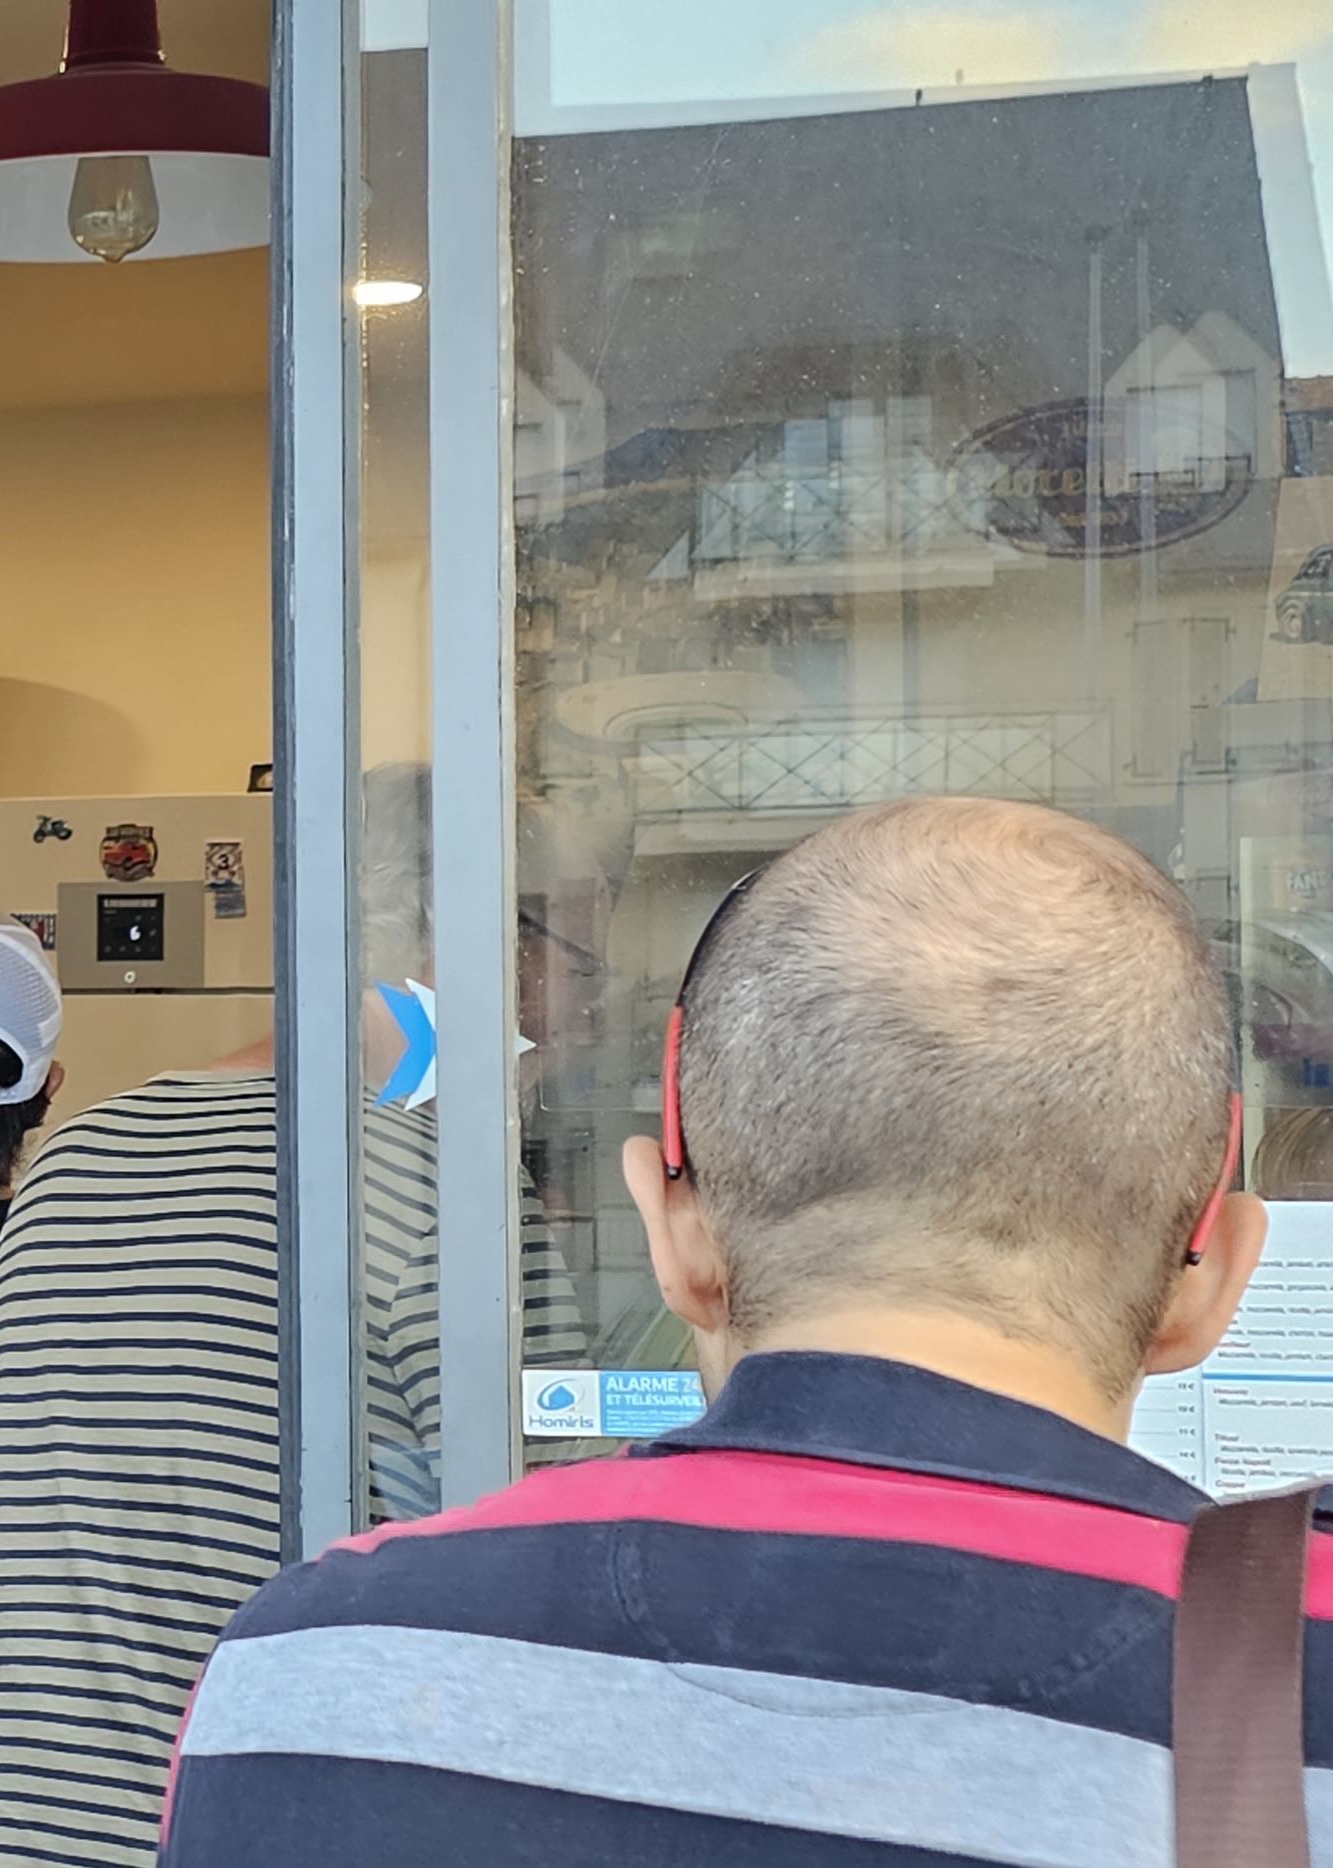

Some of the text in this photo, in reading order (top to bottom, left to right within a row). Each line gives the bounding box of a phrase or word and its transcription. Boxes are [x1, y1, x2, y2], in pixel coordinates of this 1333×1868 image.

[217, 853, 232, 870] 3
[129, 925, 142, 941] 6
[606, 1377, 679, 1393] ALARME
[606, 1394, 622, 1406] ET
[528, 1413, 595, 1429] Homiris
